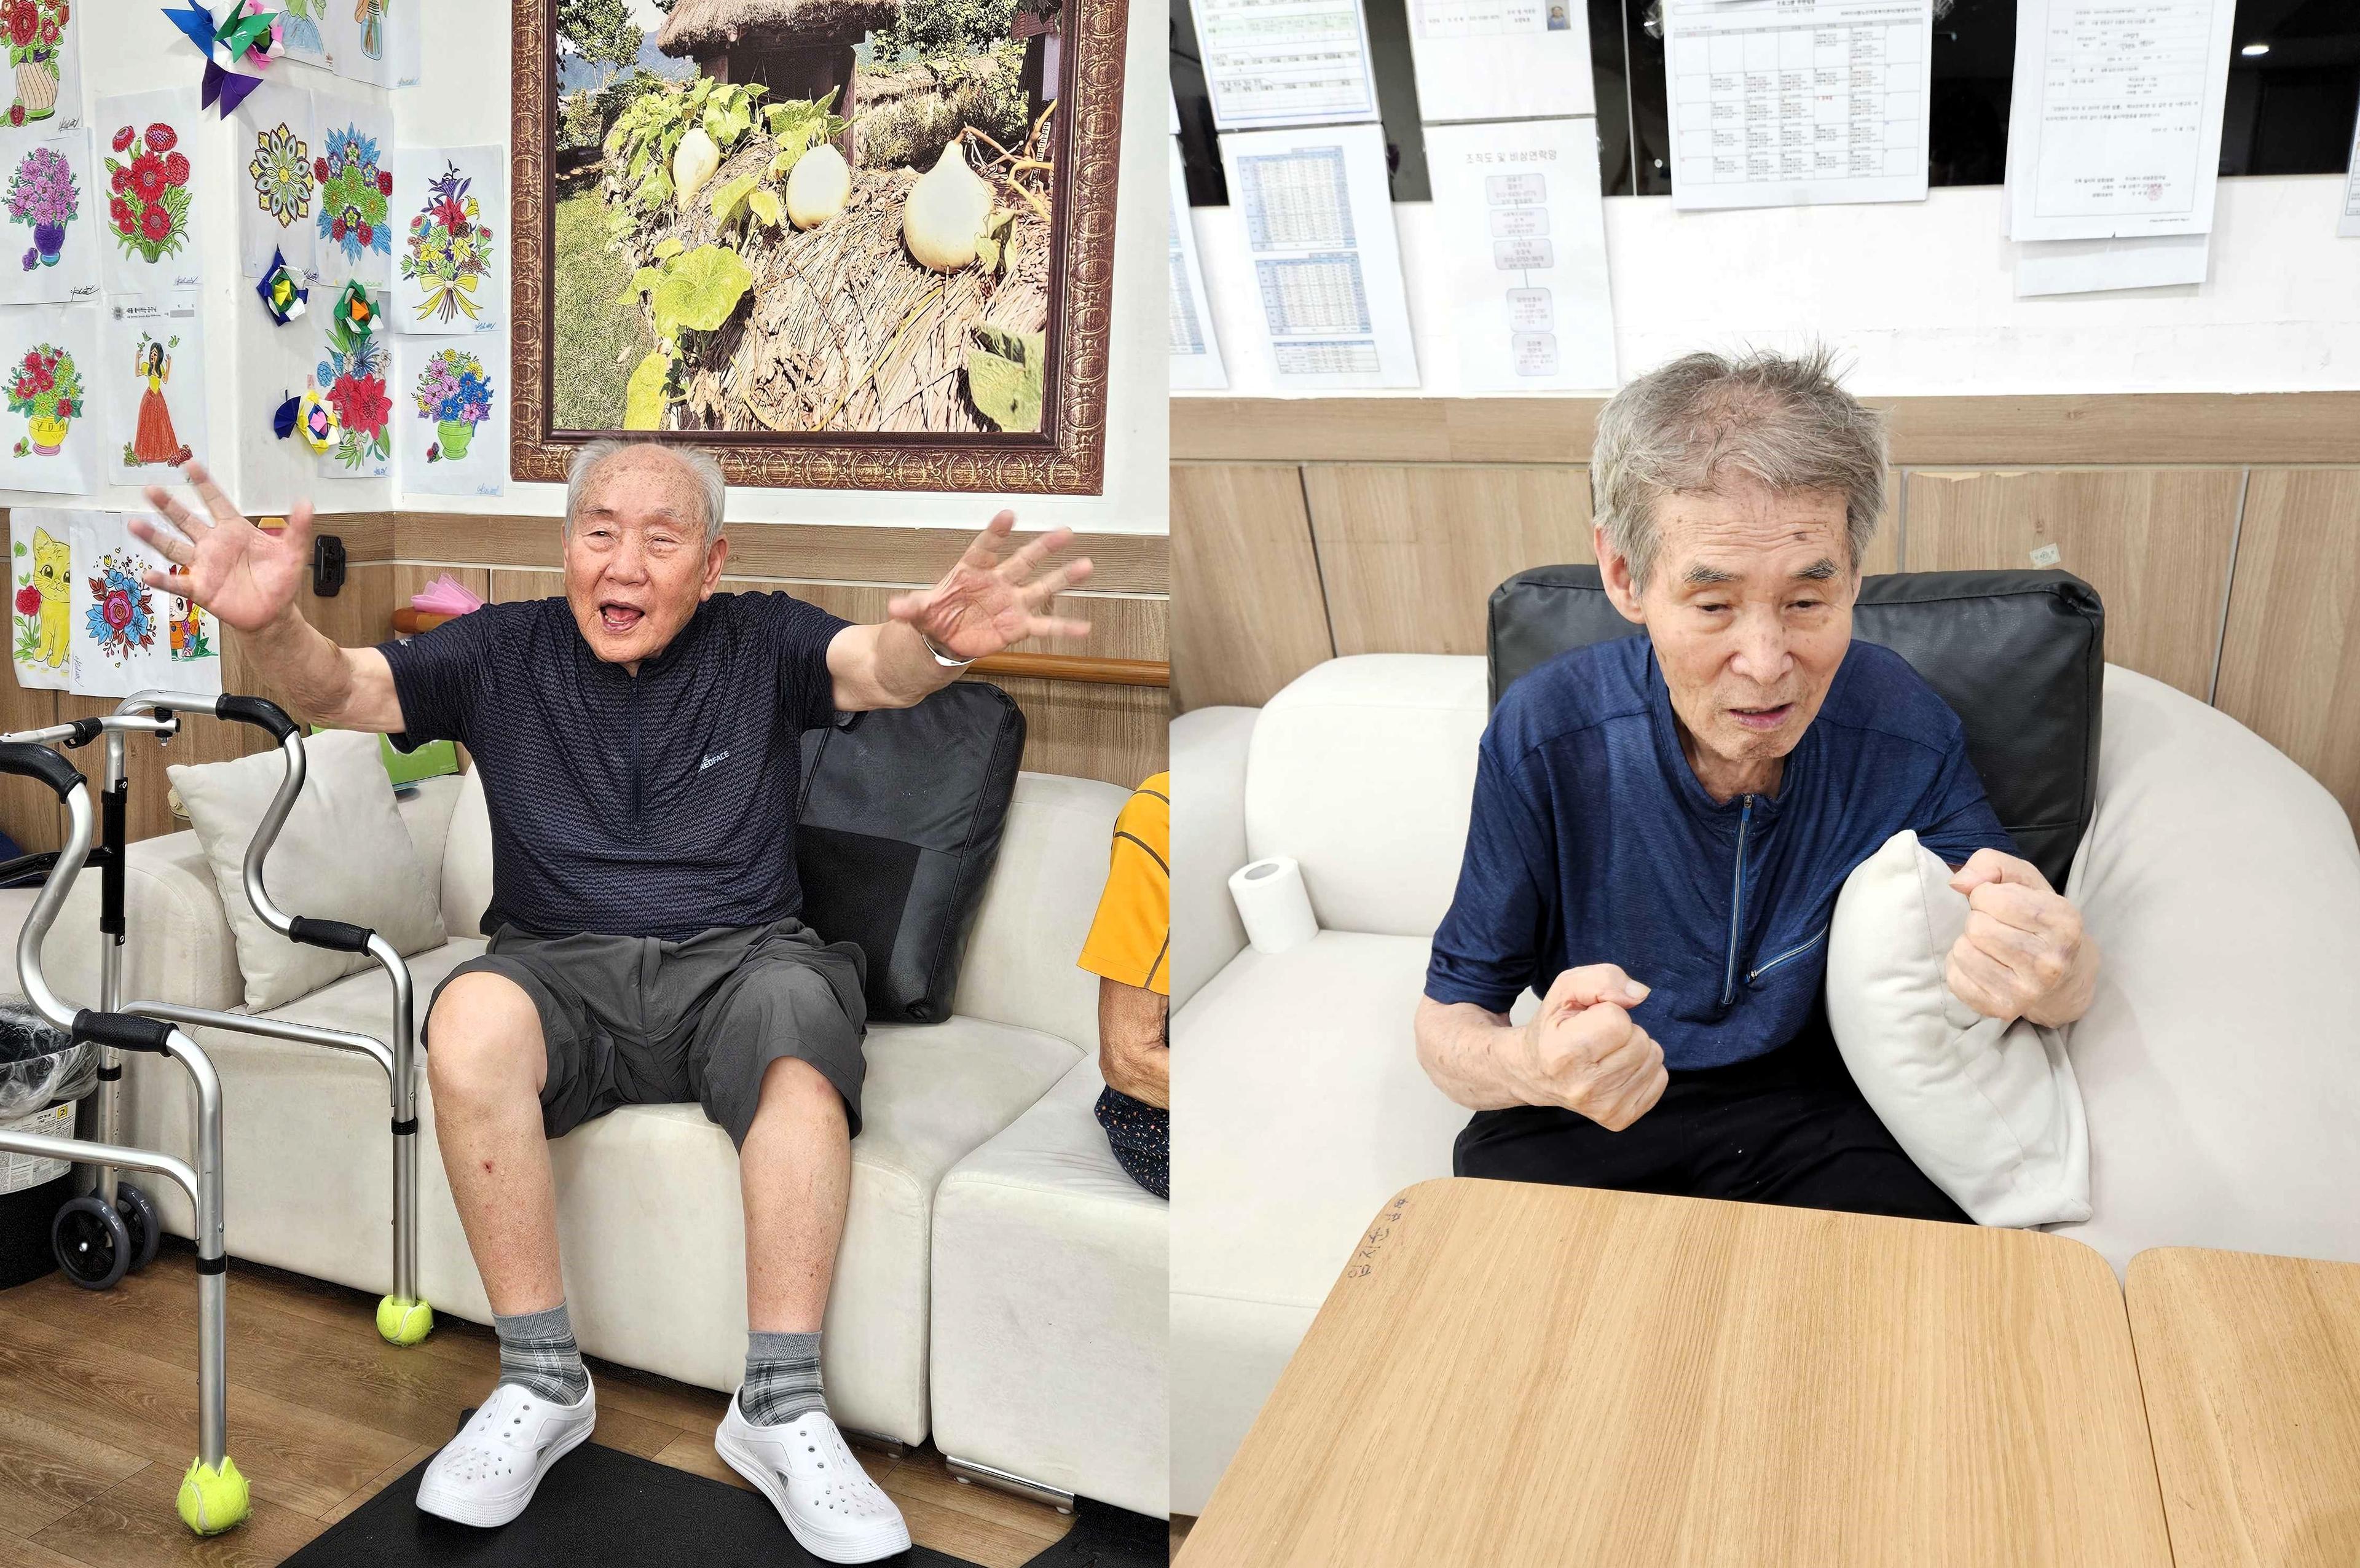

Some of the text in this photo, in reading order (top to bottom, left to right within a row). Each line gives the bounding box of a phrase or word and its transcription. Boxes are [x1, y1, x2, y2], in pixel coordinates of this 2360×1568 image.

[1466, 149, 1557, 163] 조직도 및 비상연락망
